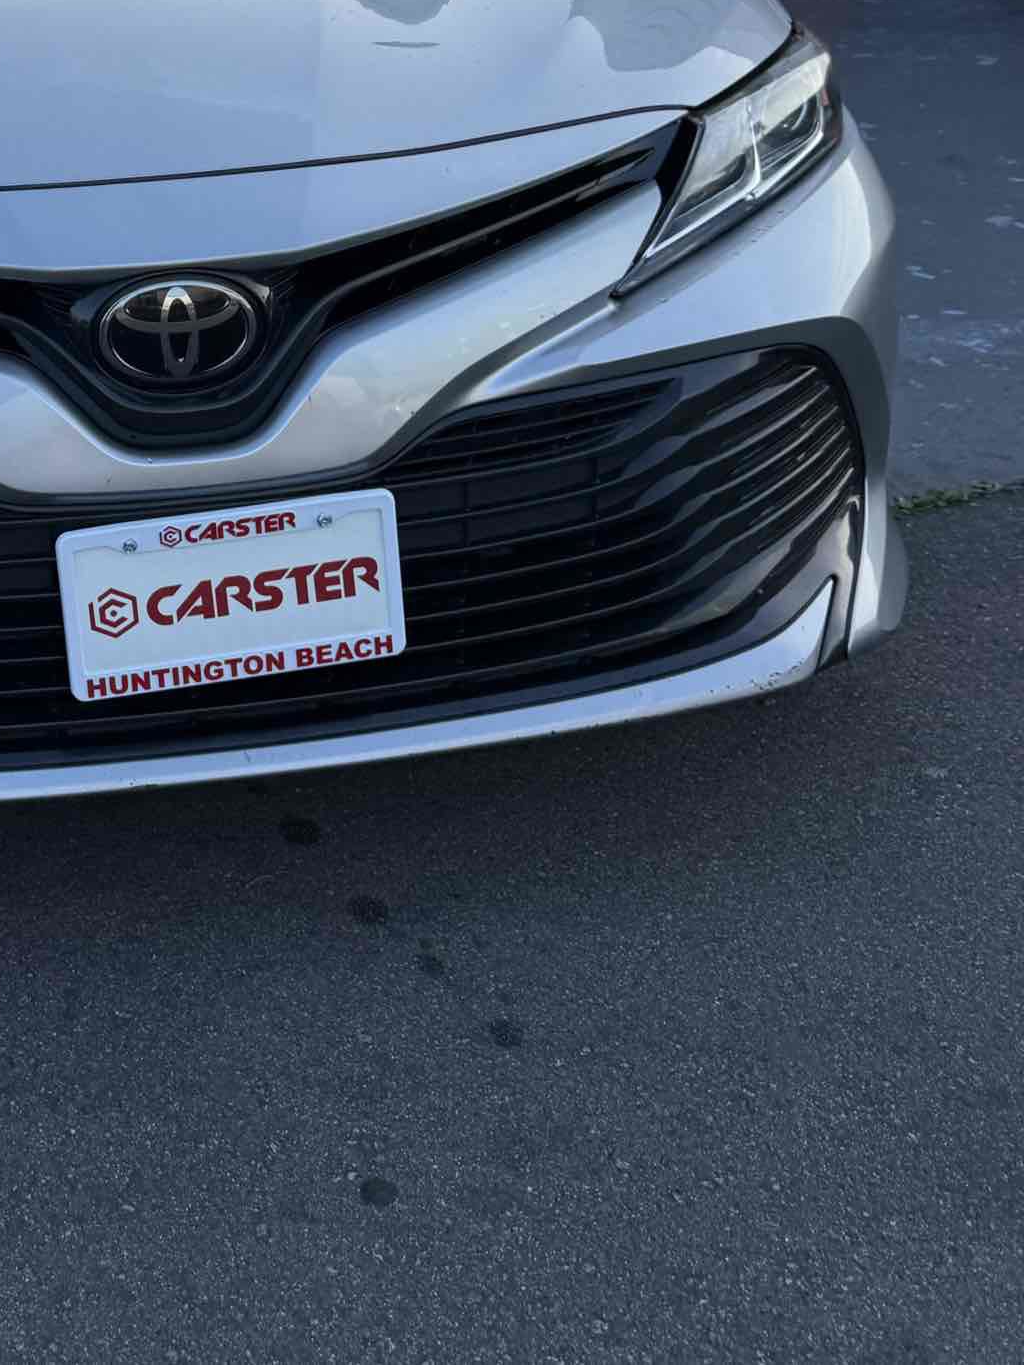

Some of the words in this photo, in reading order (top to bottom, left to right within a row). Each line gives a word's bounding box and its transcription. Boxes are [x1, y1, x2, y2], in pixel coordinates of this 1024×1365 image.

[185, 512, 296, 544] CARSTER
[146, 556, 381, 626] CARSTER
[86, 650, 285, 699] HUNTINGTON
[295, 634, 394, 668] BEACH
